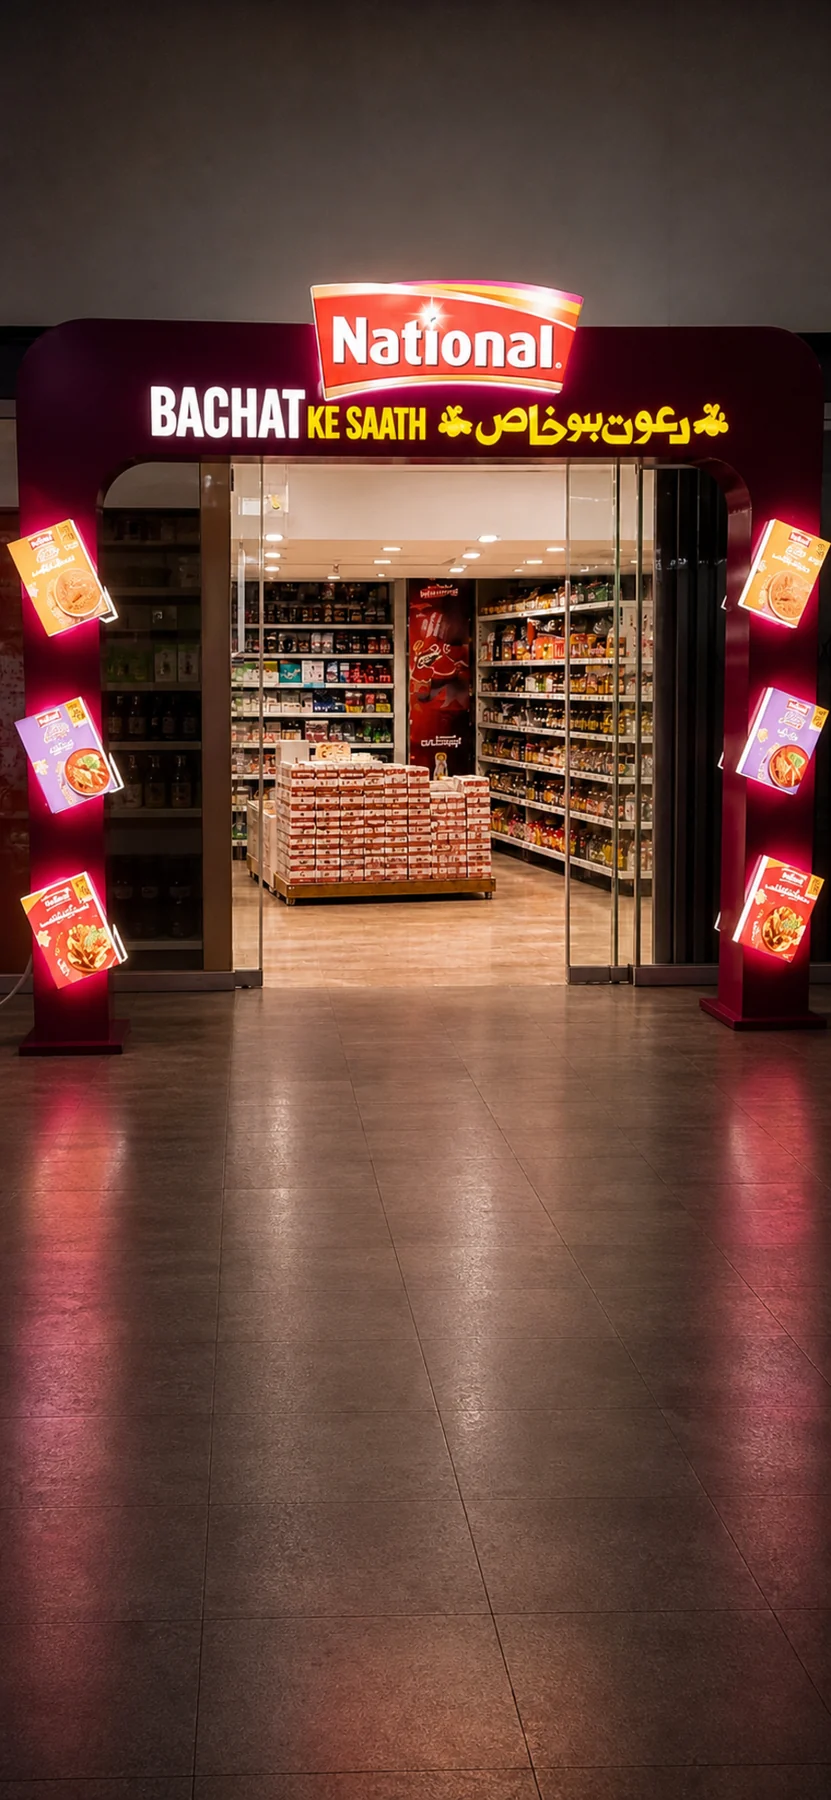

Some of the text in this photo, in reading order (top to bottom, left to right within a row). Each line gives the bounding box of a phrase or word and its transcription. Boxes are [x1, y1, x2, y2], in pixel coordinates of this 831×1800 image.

[332, 315, 554, 369] National
[150, 386, 427, 440] BACHAT KE SAATH
[475, 404, 568, 446] خاص
